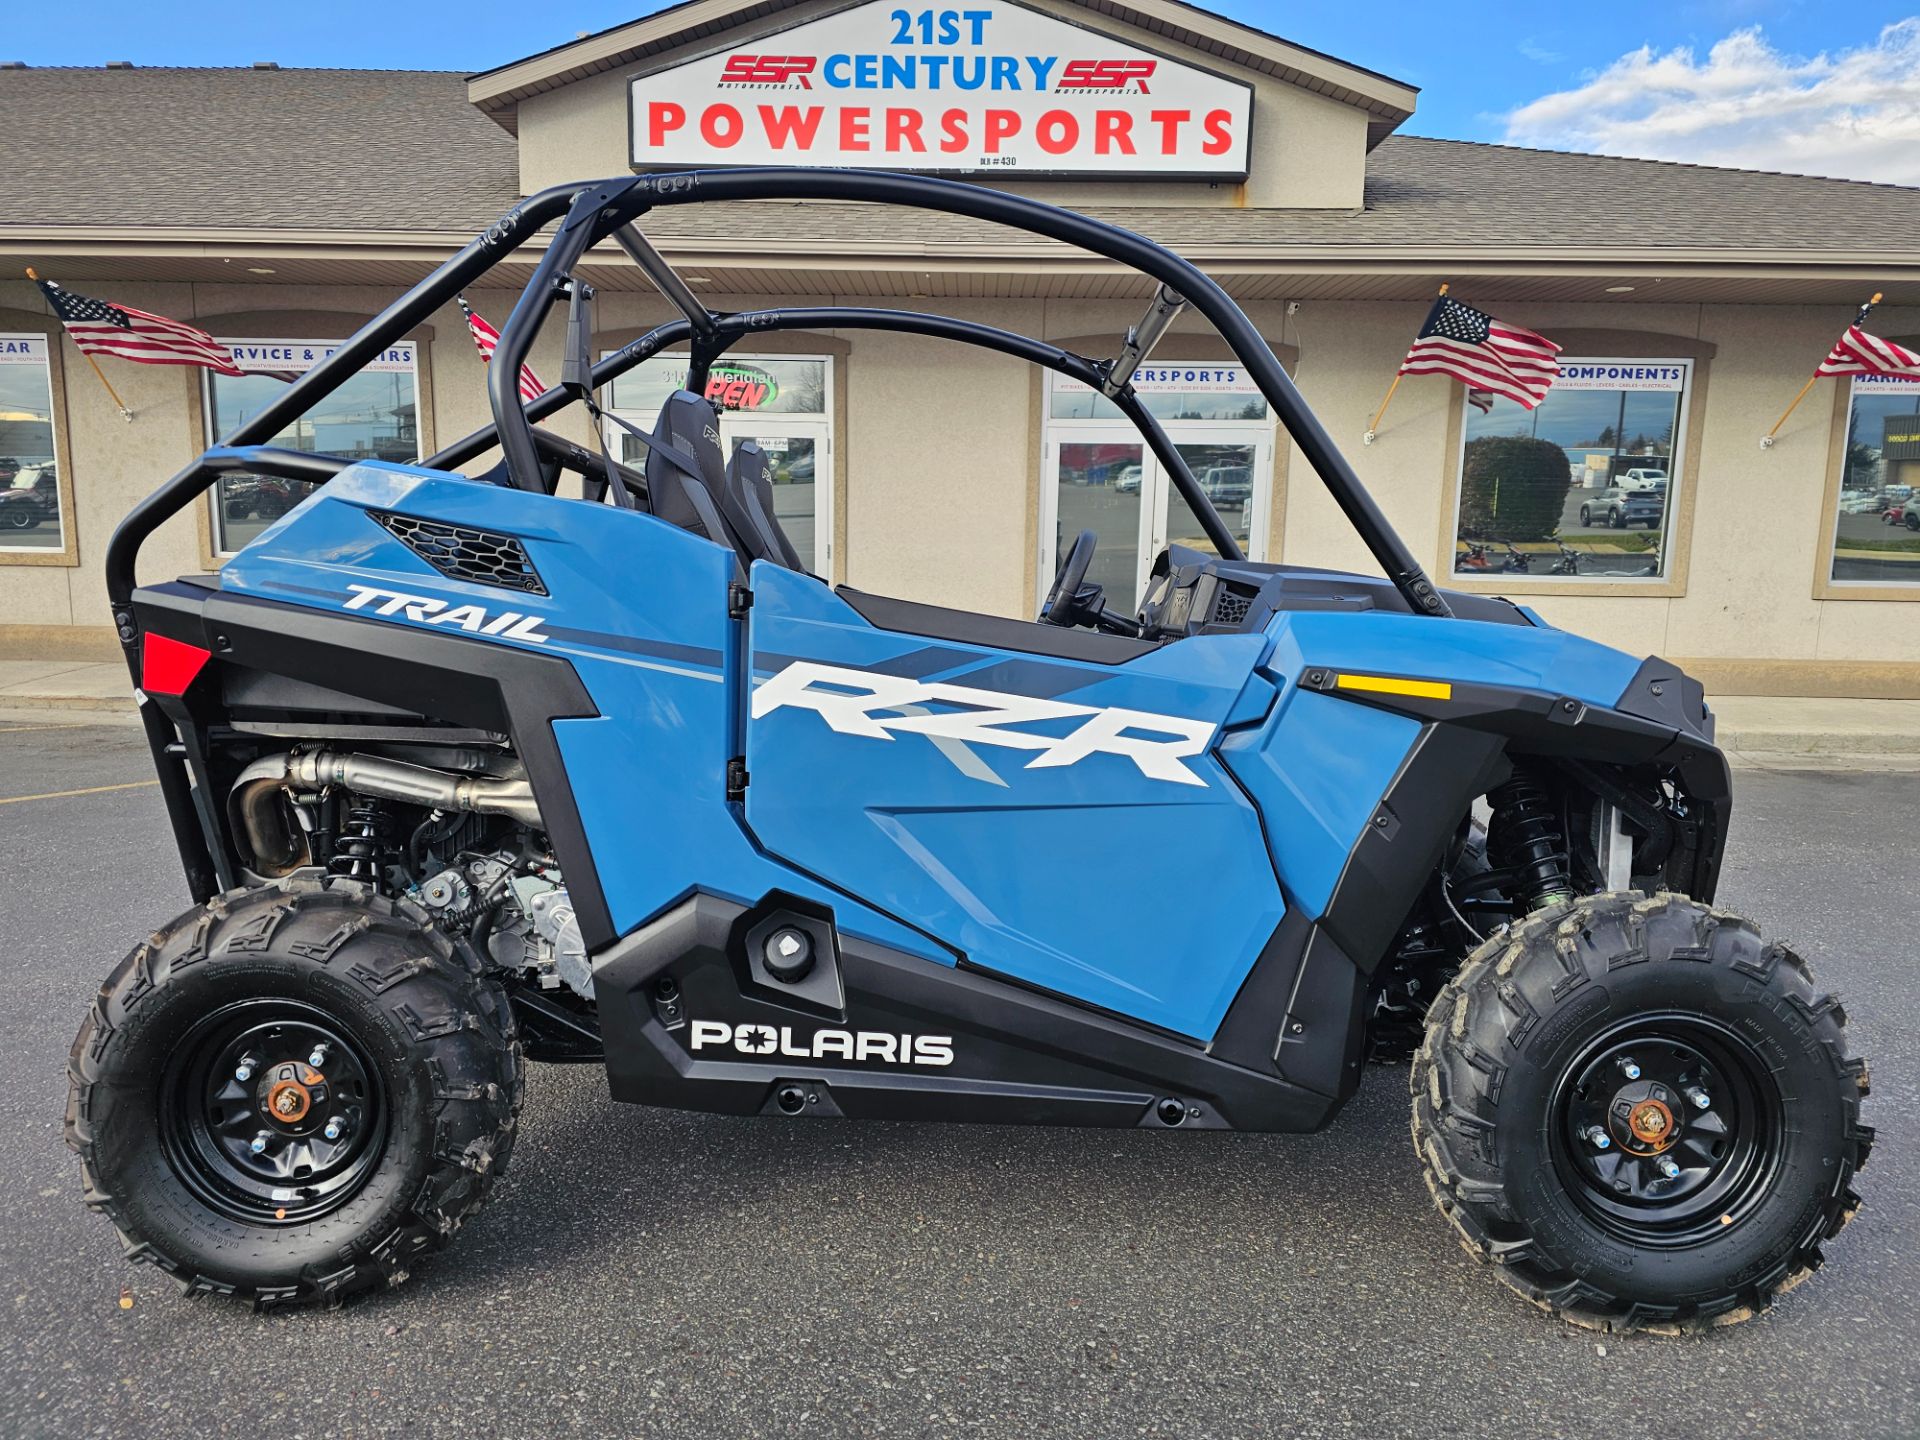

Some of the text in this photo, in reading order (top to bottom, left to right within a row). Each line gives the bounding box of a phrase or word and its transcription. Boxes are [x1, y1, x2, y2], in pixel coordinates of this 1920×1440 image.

[890, 9, 992, 46] 21ST
[720, 55, 817, 90] SSR
[823, 54, 1058, 92] CENTURY
[1058, 60, 1157, 95] SSR
[649, 101, 1233, 156] POWERSPORTS
[233, 347, 292, 360] RVICE
[303, 349, 314, 361] &
[711, 370, 777, 384] Meridian
[1133, 370, 1236, 382] ERSPORTS
[1558, 367, 1680, 380] COMPONENTS
[686, 380, 766, 410] PEN
[342, 584, 550, 643] TRAIL
[751, 661, 1217, 788] RZR
[690, 1019, 954, 1066] POLARIS
